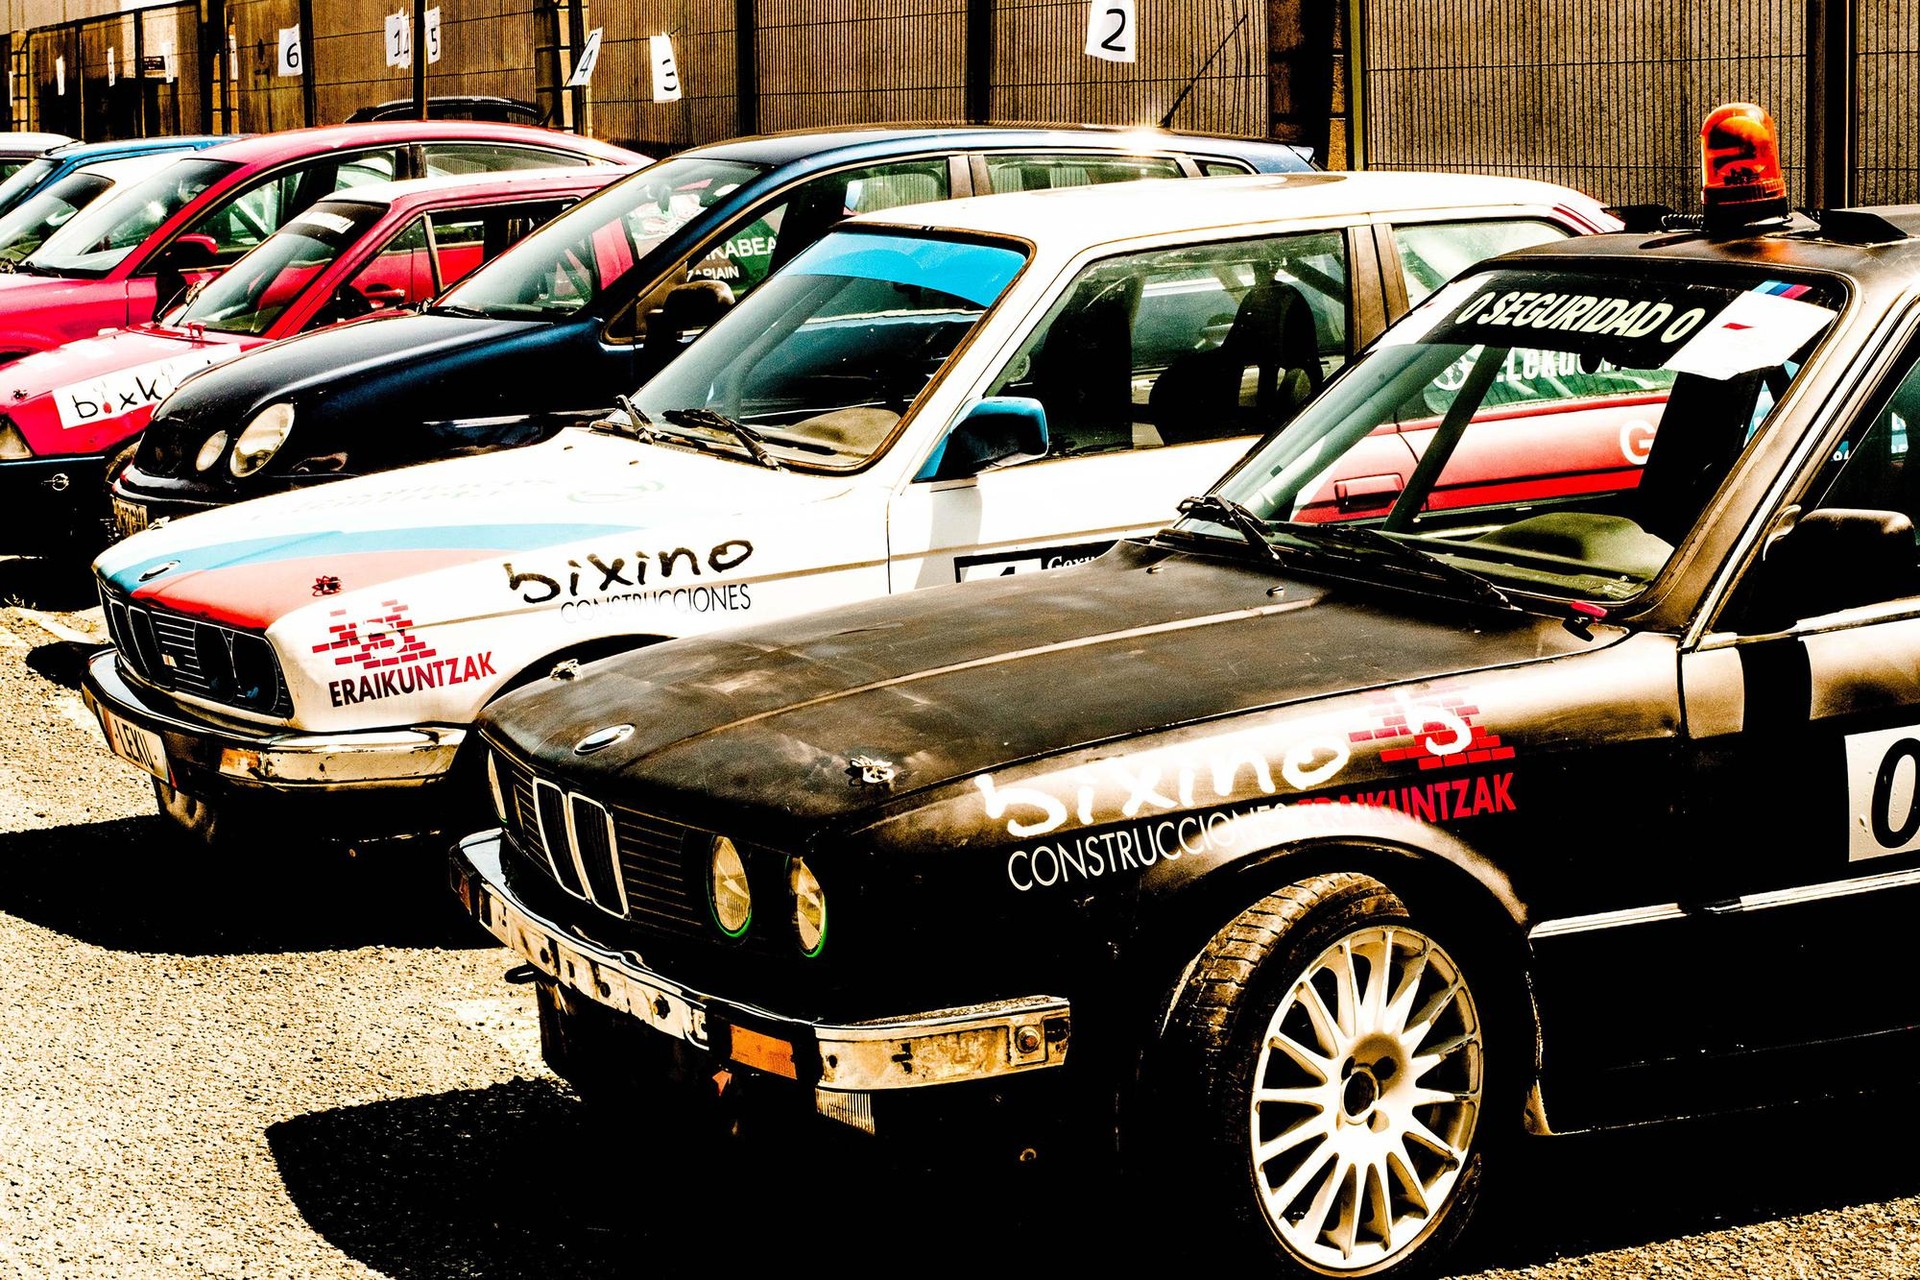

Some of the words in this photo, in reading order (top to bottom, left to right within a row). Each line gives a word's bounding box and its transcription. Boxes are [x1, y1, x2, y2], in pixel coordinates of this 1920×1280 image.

[430, 27, 438, 55] 5
[1101, 8, 1127, 52] 2
[286, 43, 300, 69] 6
[580, 50, 595, 79] 4
[662, 57, 678, 93] 3
[1477, 291, 1674, 339] SEGURIDAD
[503, 539, 754, 603] bixino
[327, 651, 497, 708] ERAIKUNTZAK
[974, 736, 1349, 838] bixino
